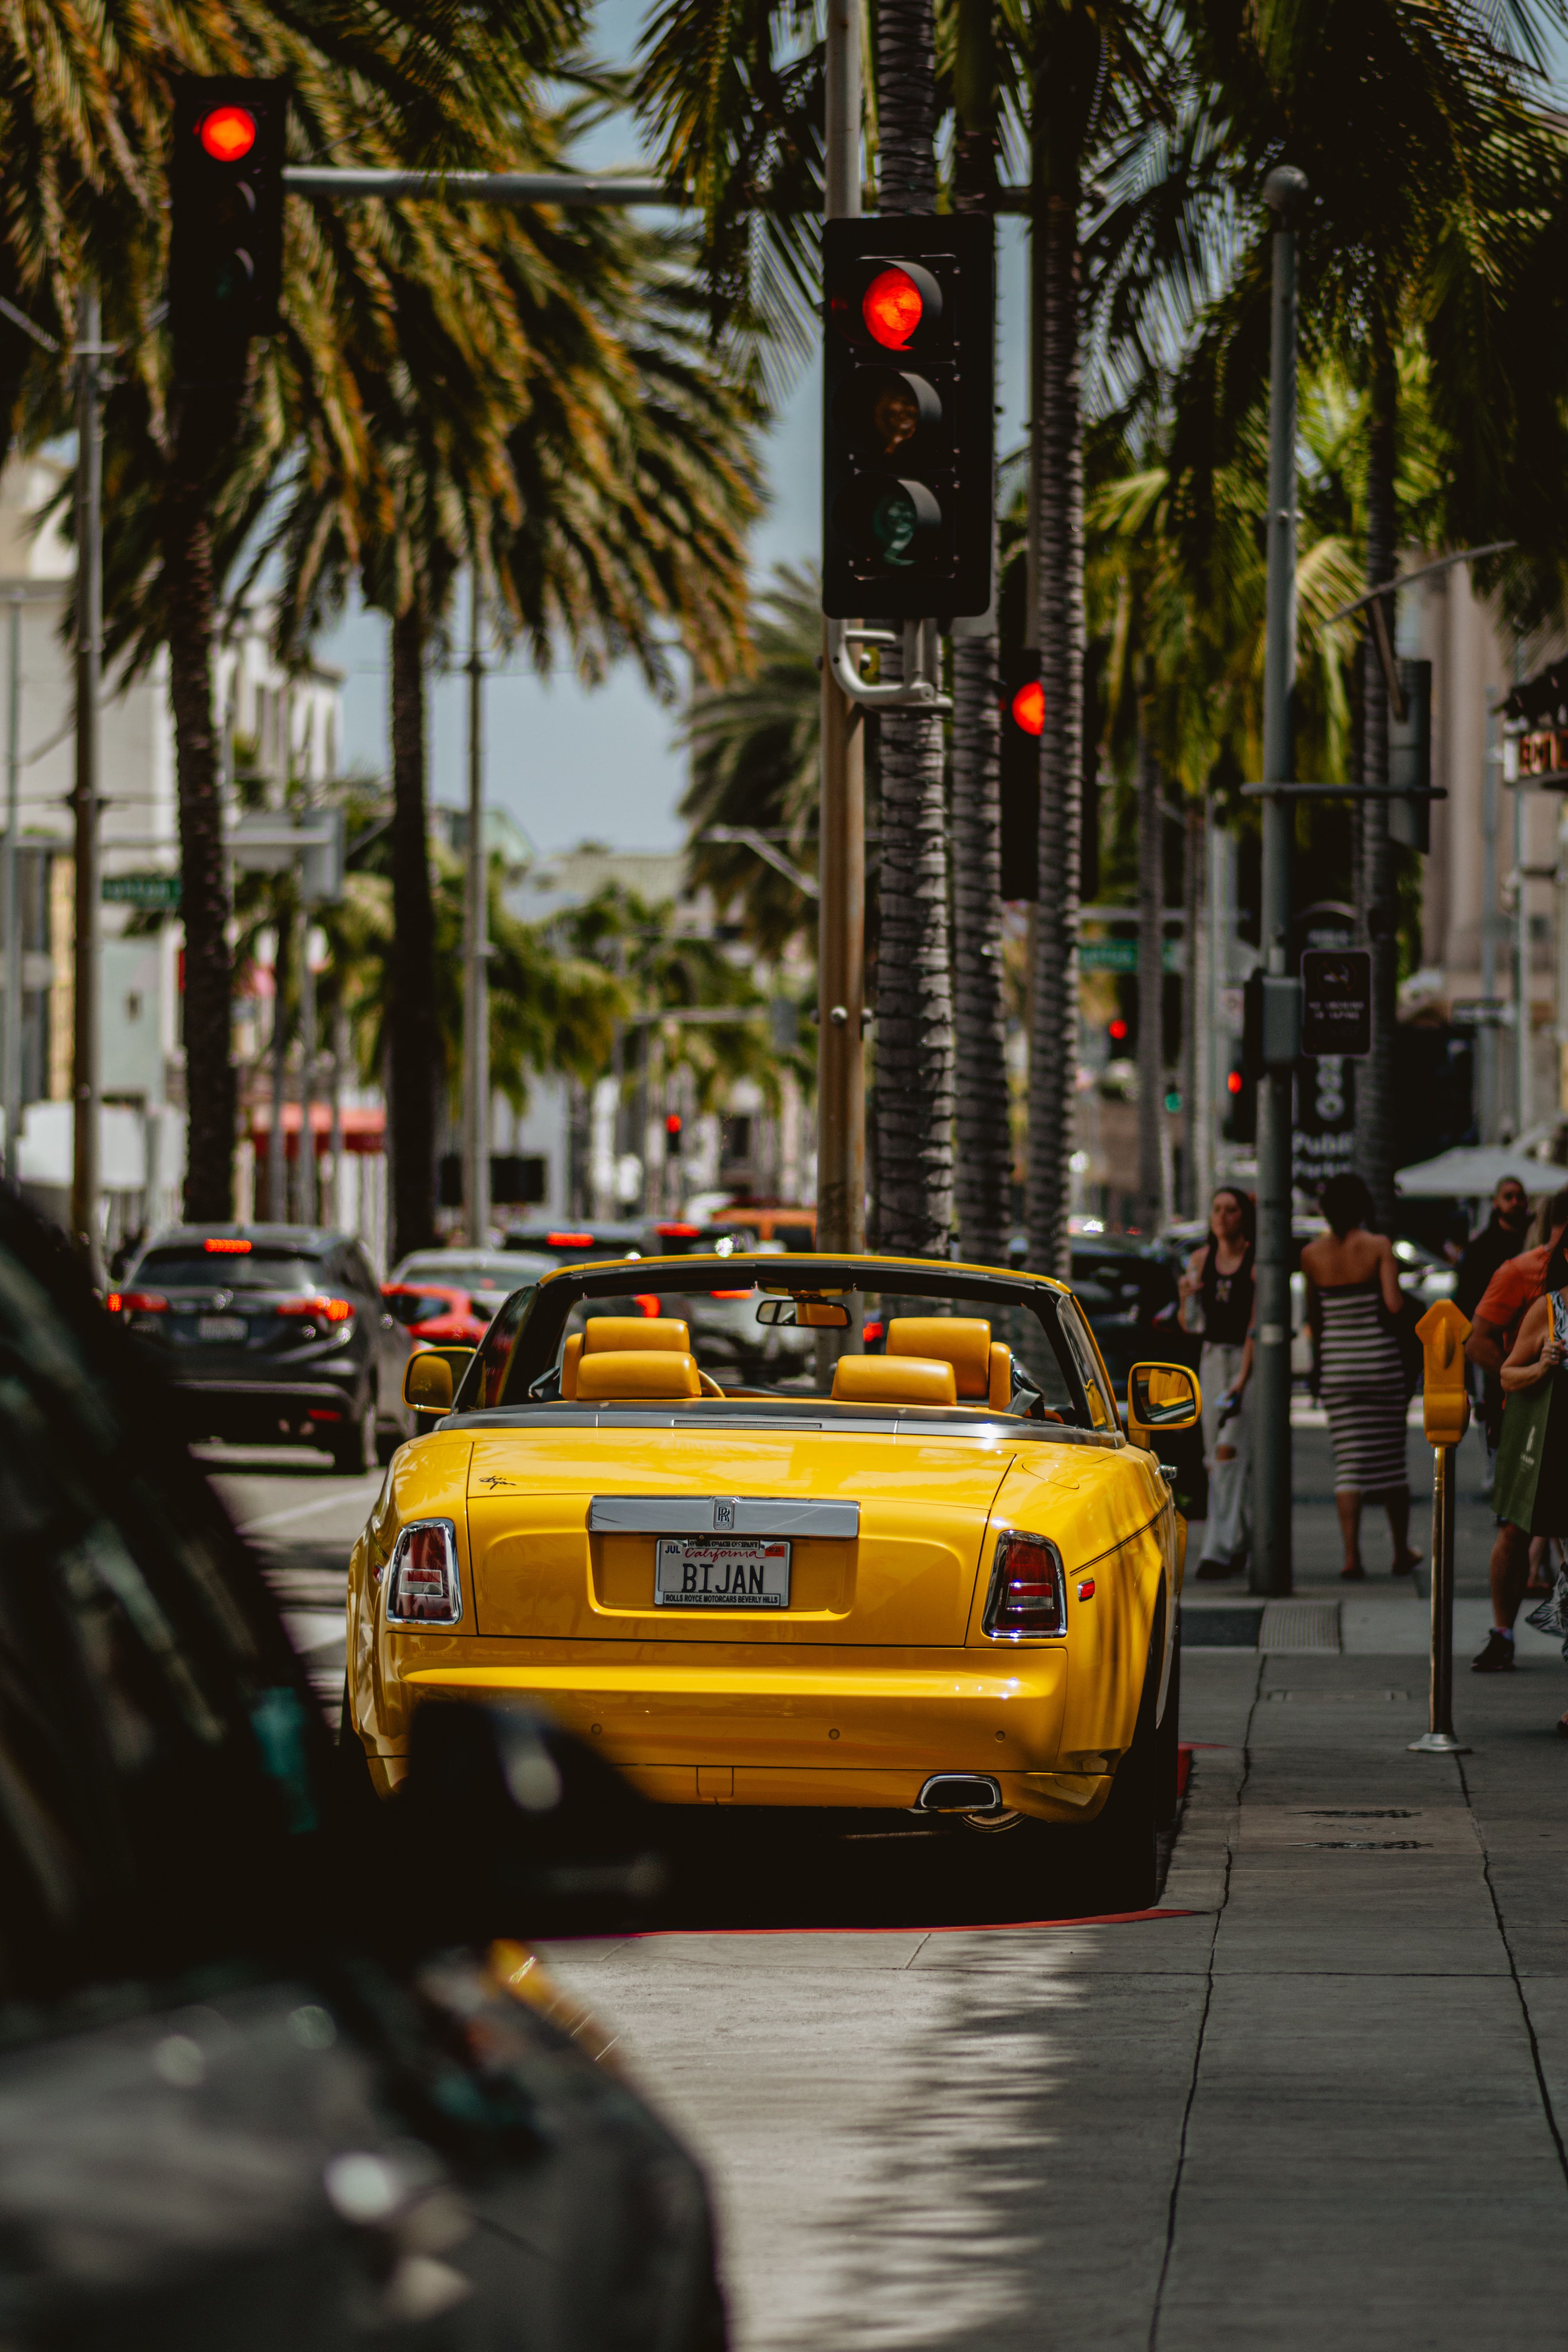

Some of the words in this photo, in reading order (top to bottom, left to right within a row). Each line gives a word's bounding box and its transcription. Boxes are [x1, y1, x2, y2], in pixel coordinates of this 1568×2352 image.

[1292, 1131, 1353, 1155] Publi
[665, 1545, 680, 1554] JUL
[685, 1548, 765, 1563] California
[681, 1563, 764, 1593] BIJAN
